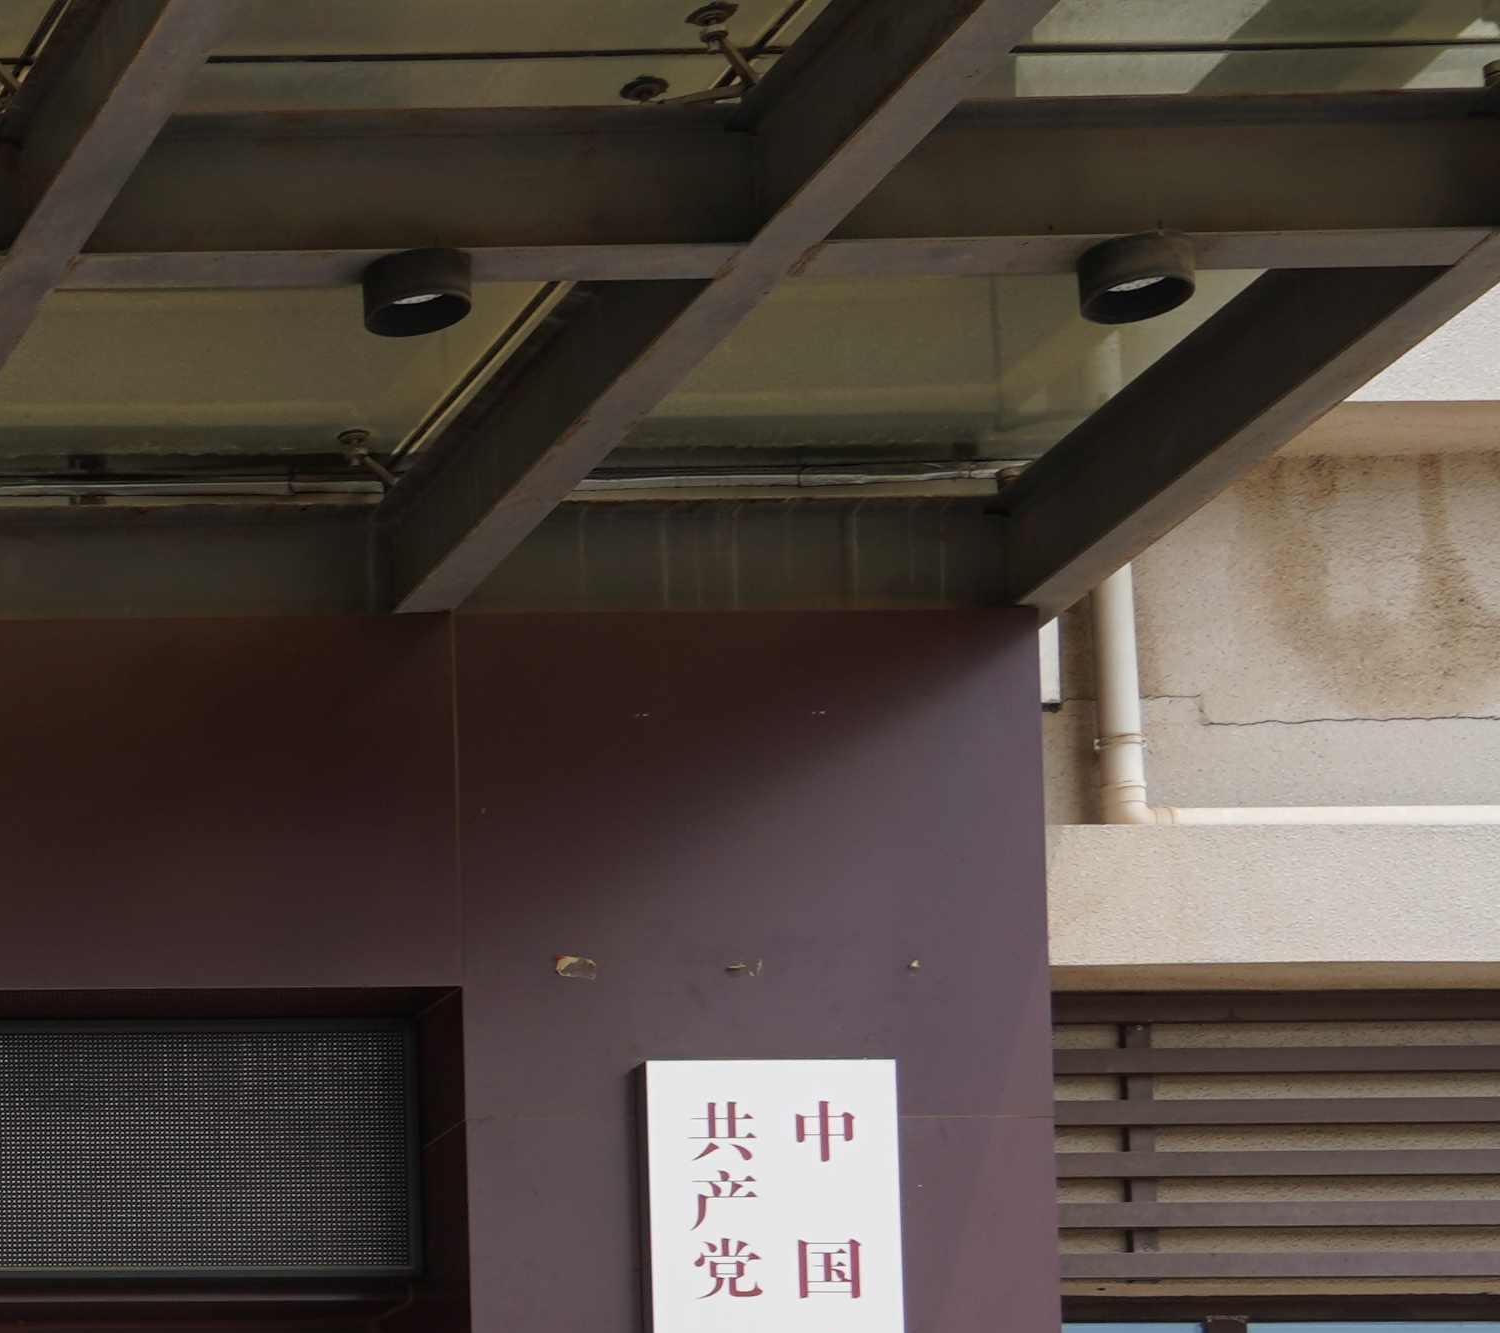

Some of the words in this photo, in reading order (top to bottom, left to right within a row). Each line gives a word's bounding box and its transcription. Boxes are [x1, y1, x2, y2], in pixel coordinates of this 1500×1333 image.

[687, 1101, 763, 1300] 共产党
[795, 1100, 861, 1299] 中国
